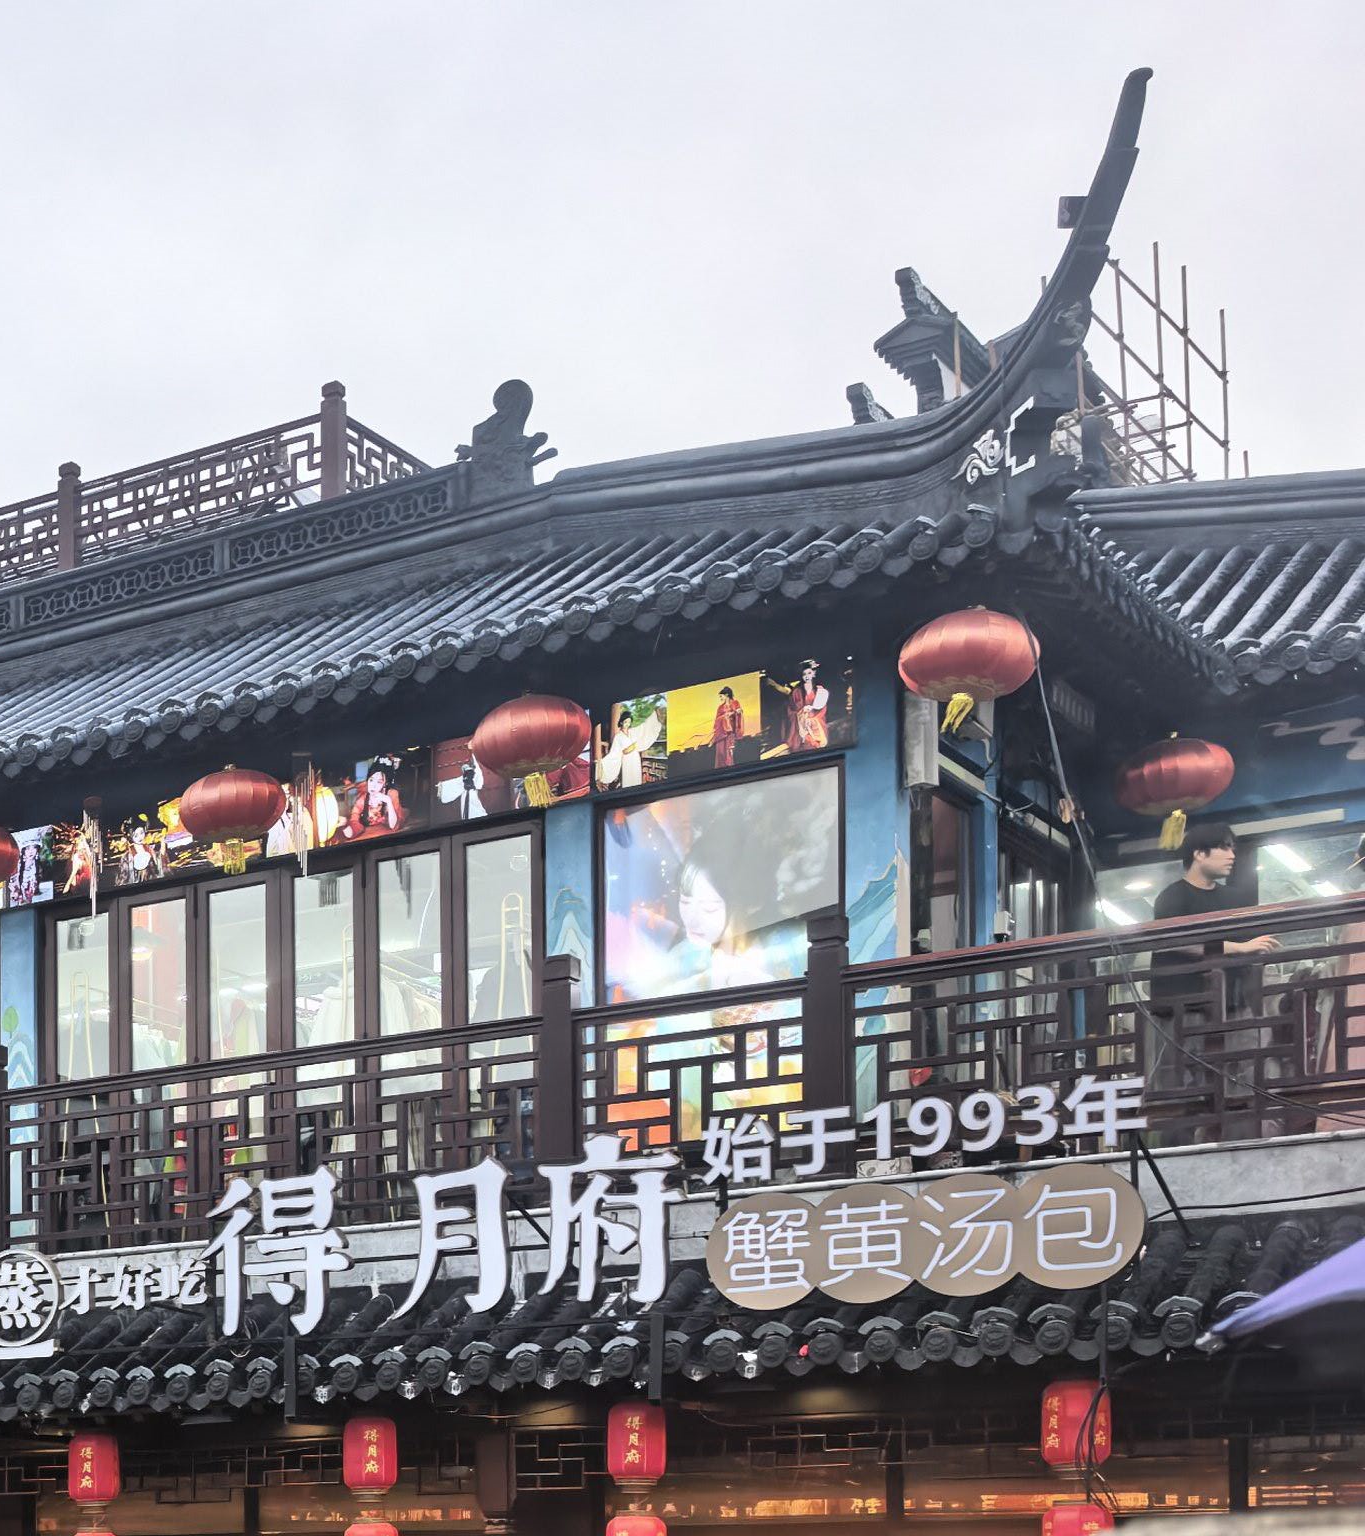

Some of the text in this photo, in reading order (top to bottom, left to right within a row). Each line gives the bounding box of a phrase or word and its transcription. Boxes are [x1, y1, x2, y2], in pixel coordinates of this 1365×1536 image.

[701, 1075, 1149, 1185] 始于1993年
[207, 1133, 684, 1336] 得月府
[721, 1184, 1124, 1294] 蟹黄汤包
[80, 1446, 94, 1490] 得月府
[363, 1429, 379, 1475] 得月府
[624, 1415, 643, 1465] 得月府
